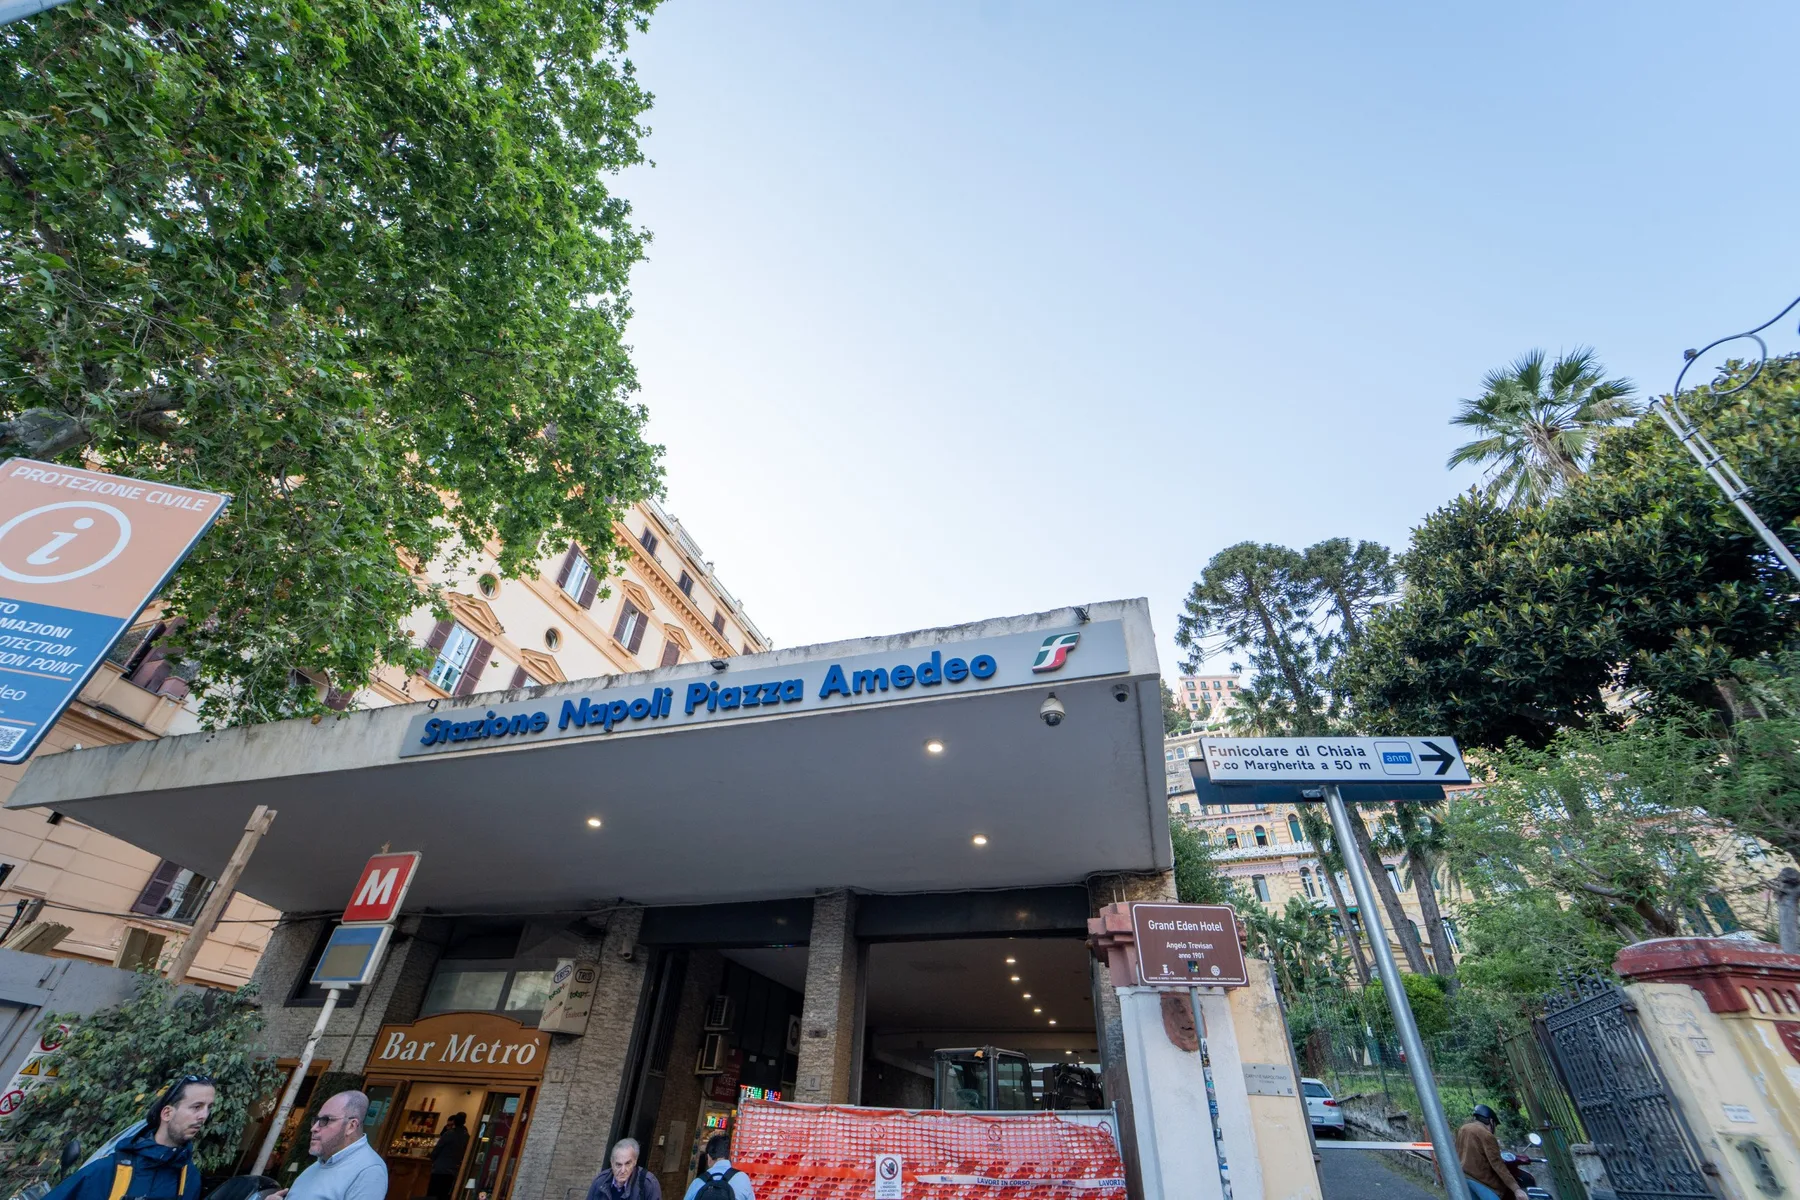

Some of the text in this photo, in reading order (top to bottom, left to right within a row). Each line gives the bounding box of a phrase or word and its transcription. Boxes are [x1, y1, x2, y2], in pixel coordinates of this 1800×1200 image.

[10, 466, 209, 512] PROTEZIONE CIVILE
[27, 657, 83, 675] POINT
[420, 651, 998, 746] Stazione Napoli Piazza Amedeo
[1208, 745, 1367, 757] Funicolare di Chiaia
[1386, 754, 1409, 763] anm
[1213, 760, 1371, 771] P.co Margherita a 50 m
[354, 868, 399, 906] M
[1148, 919, 1224, 932] Grand Eden Hotel
[1166, 941, 1213, 950] Angelo Trevisan
[378, 1032, 541, 1065] Bar Metrò
[977, 1177, 999, 1186] LAVORI
[1099, 1179, 1121, 1187] LAVORI
